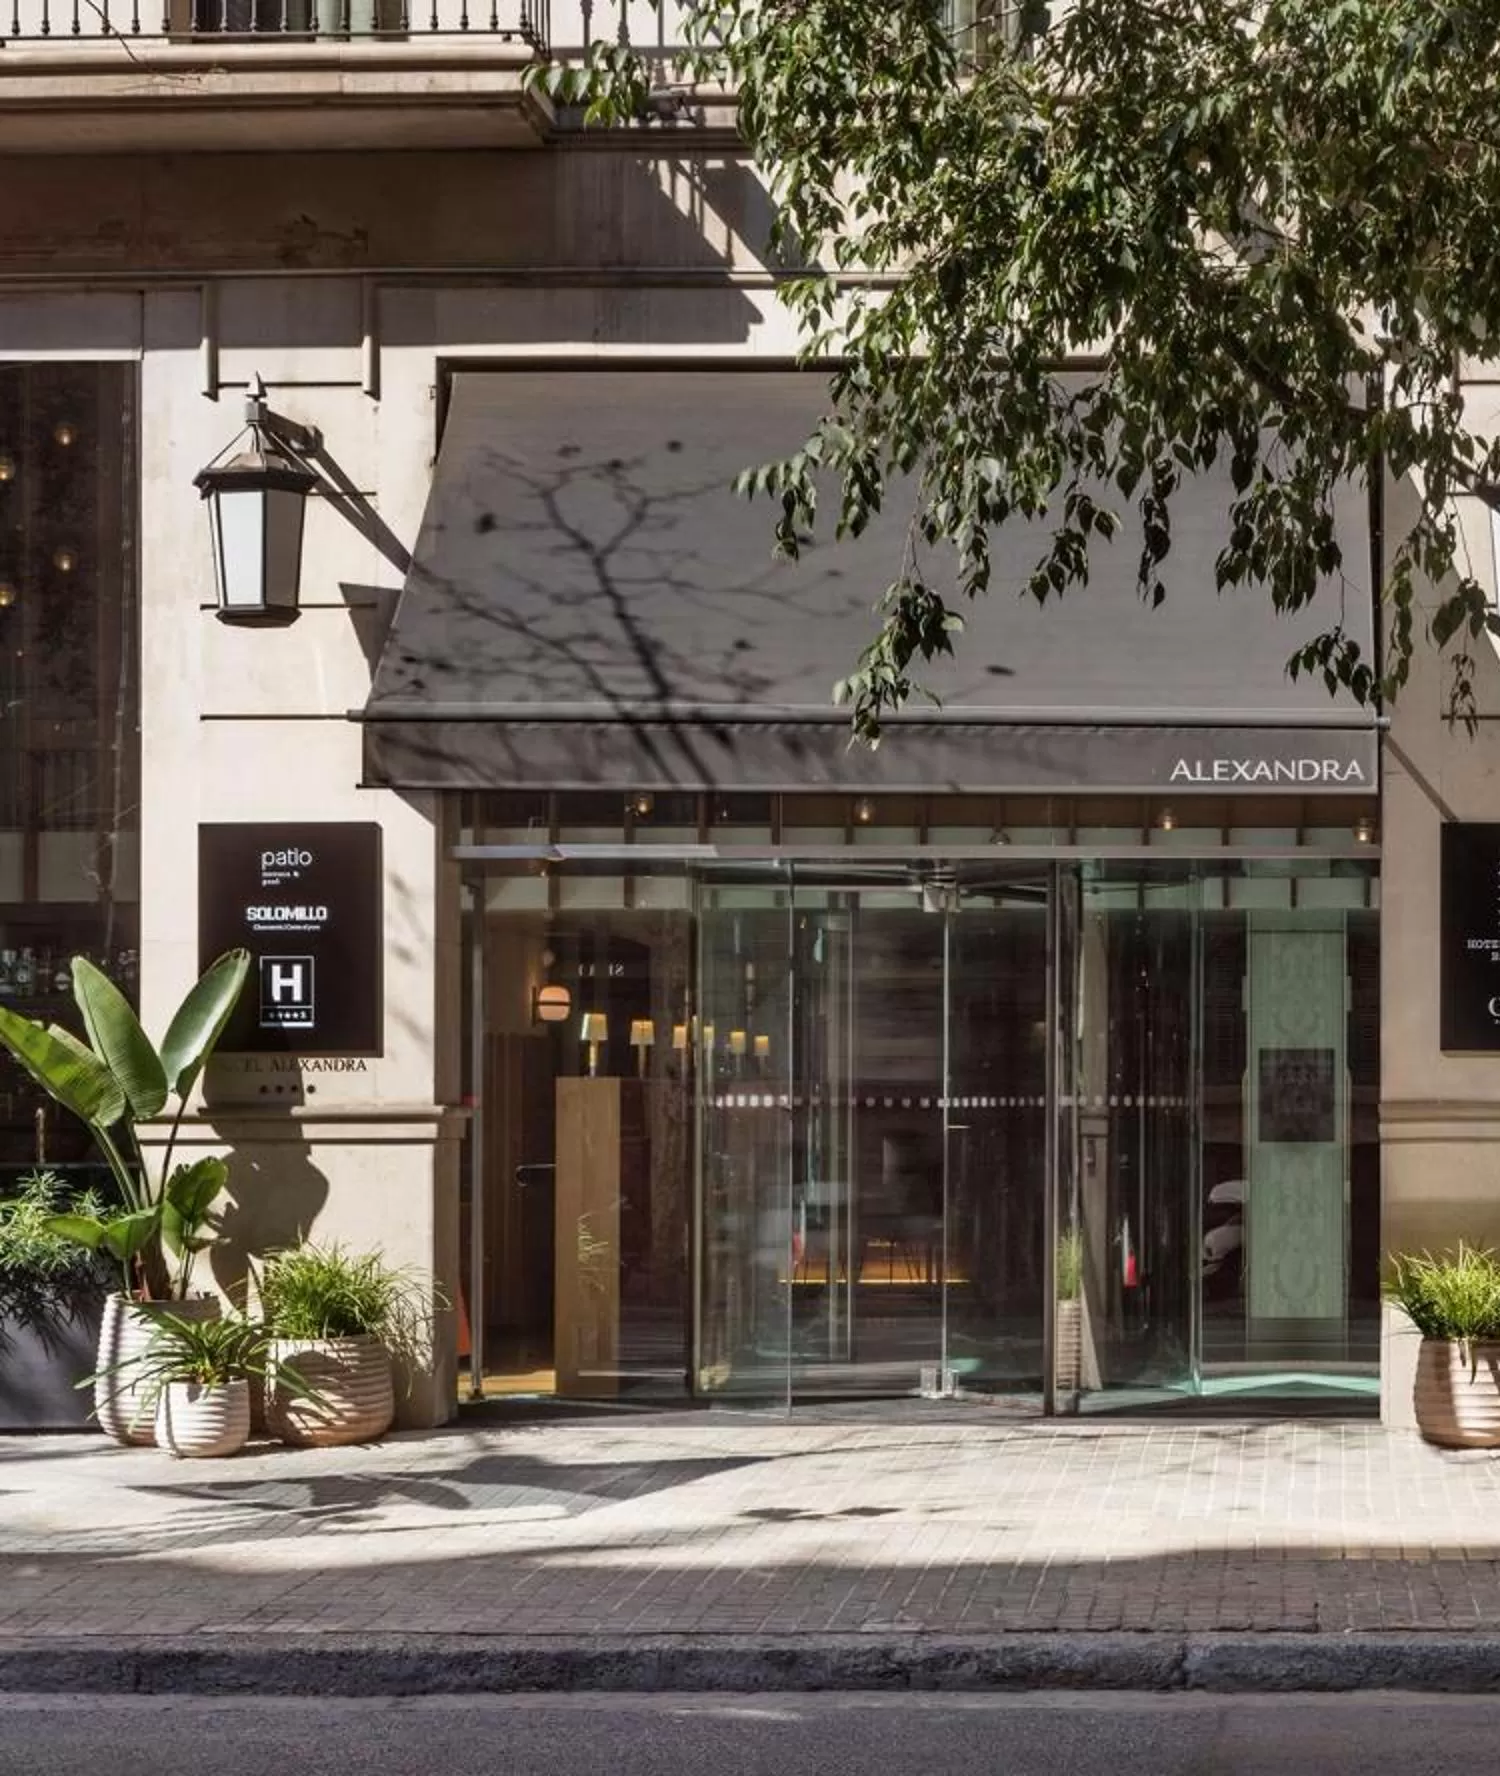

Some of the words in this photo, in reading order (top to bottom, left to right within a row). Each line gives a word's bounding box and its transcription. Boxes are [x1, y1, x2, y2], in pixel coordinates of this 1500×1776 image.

[1170, 759, 1364, 781] ALEXANDRA
[261, 848, 312, 870] patio
[246, 906, 327, 921] SOLOMILLO
[271, 964, 302, 1002] H
[270, 1059, 368, 1073] ALEXANDRA
